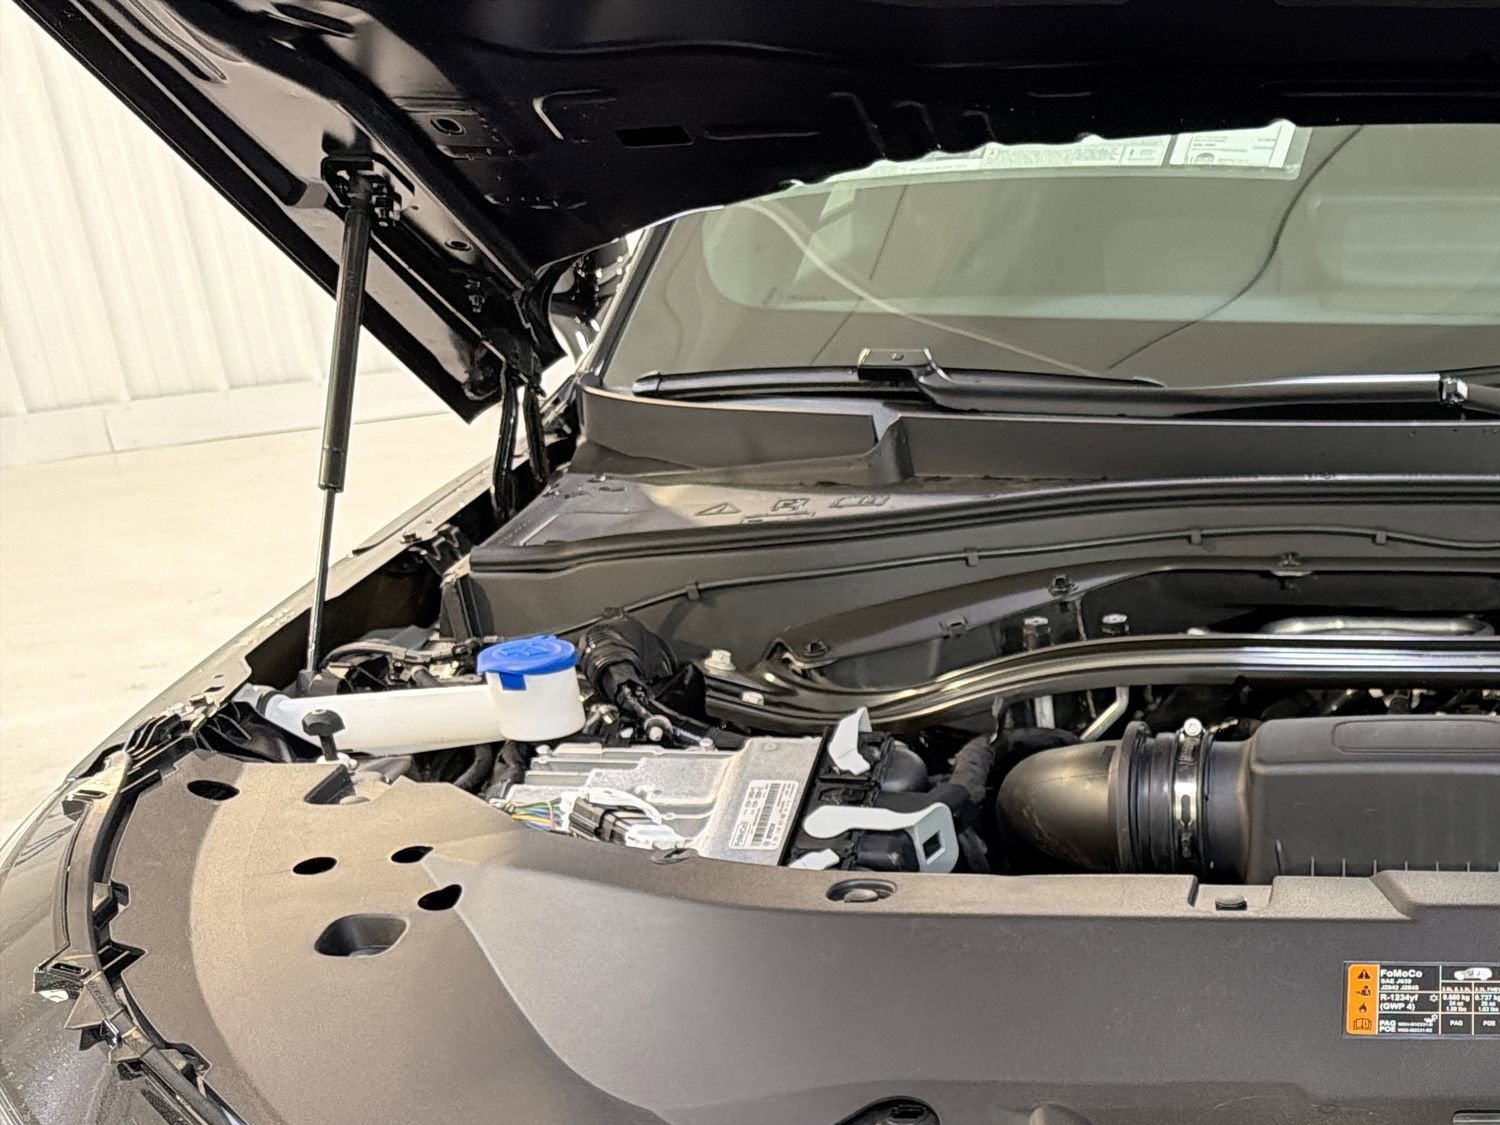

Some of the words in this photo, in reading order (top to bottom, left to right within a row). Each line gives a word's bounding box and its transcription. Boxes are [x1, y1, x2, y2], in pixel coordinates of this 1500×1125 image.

[1380, 969, 1423, 978] FoMoCo
[1380, 994, 1419, 1003] R-1234yf
[1461, 994, 1470, 1002] kg
[1380, 1002, 1405, 1011] (GWP
[1406, 1002, 1416, 1011] 4)
